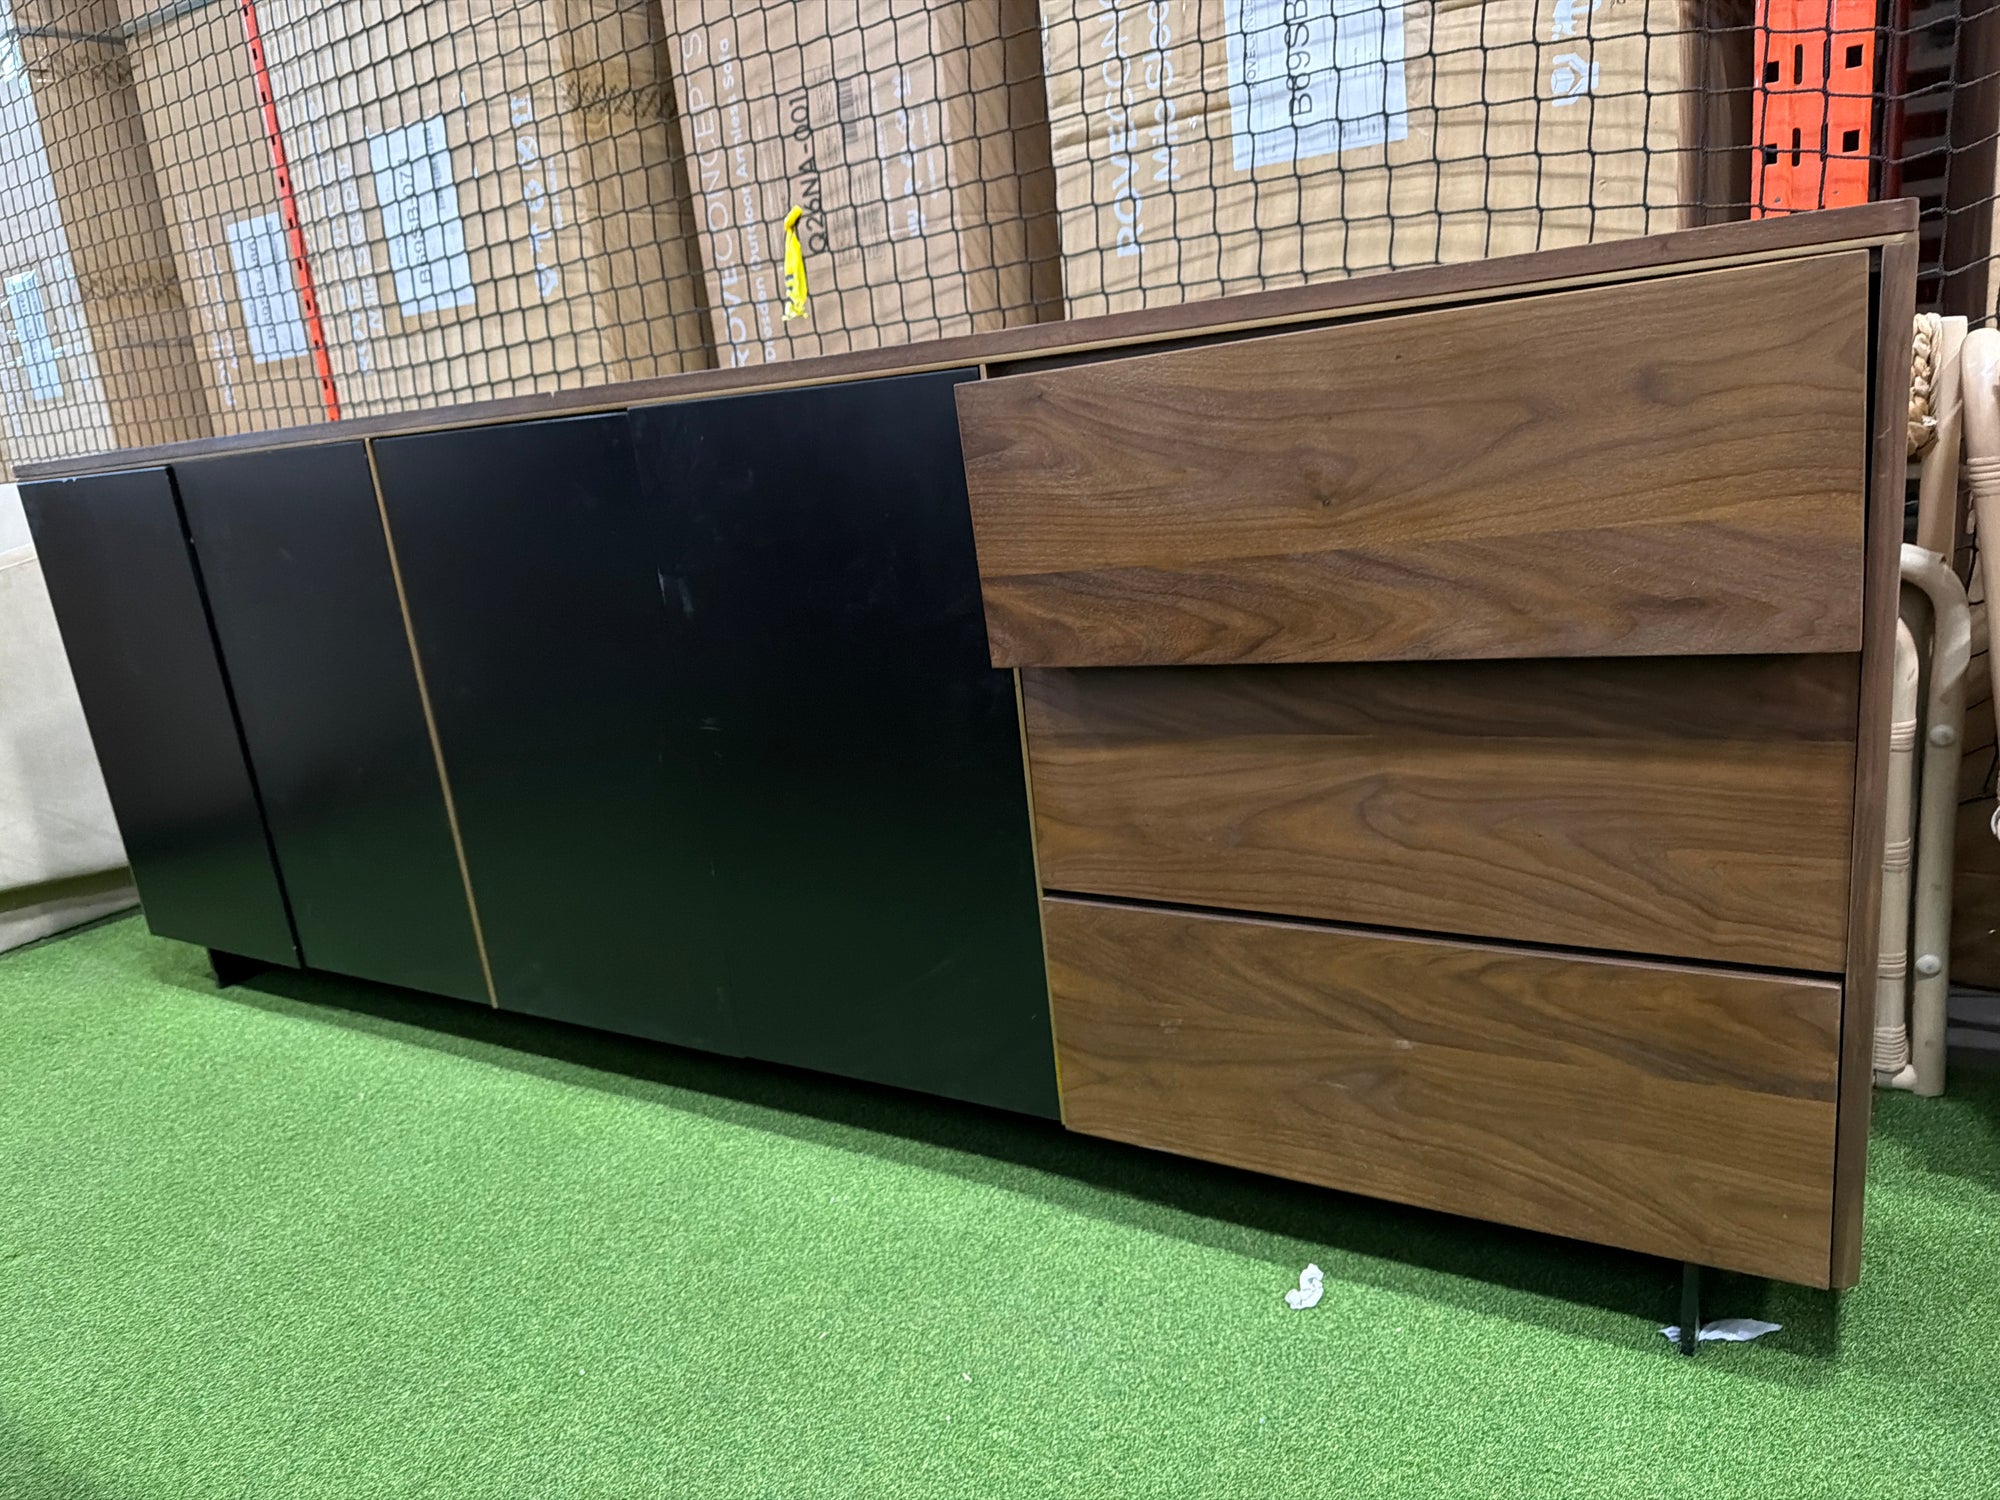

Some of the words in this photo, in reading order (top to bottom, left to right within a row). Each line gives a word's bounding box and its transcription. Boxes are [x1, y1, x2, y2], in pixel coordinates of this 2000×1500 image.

[719, 37, 735, 91] Sofa
[1097, 0, 1145, 257] ROVECON
[1148, 98, 1181, 182] Milo
[789, 90, 829, 254] Q26NA-001
[743, 186, 763, 271] Outdoor
